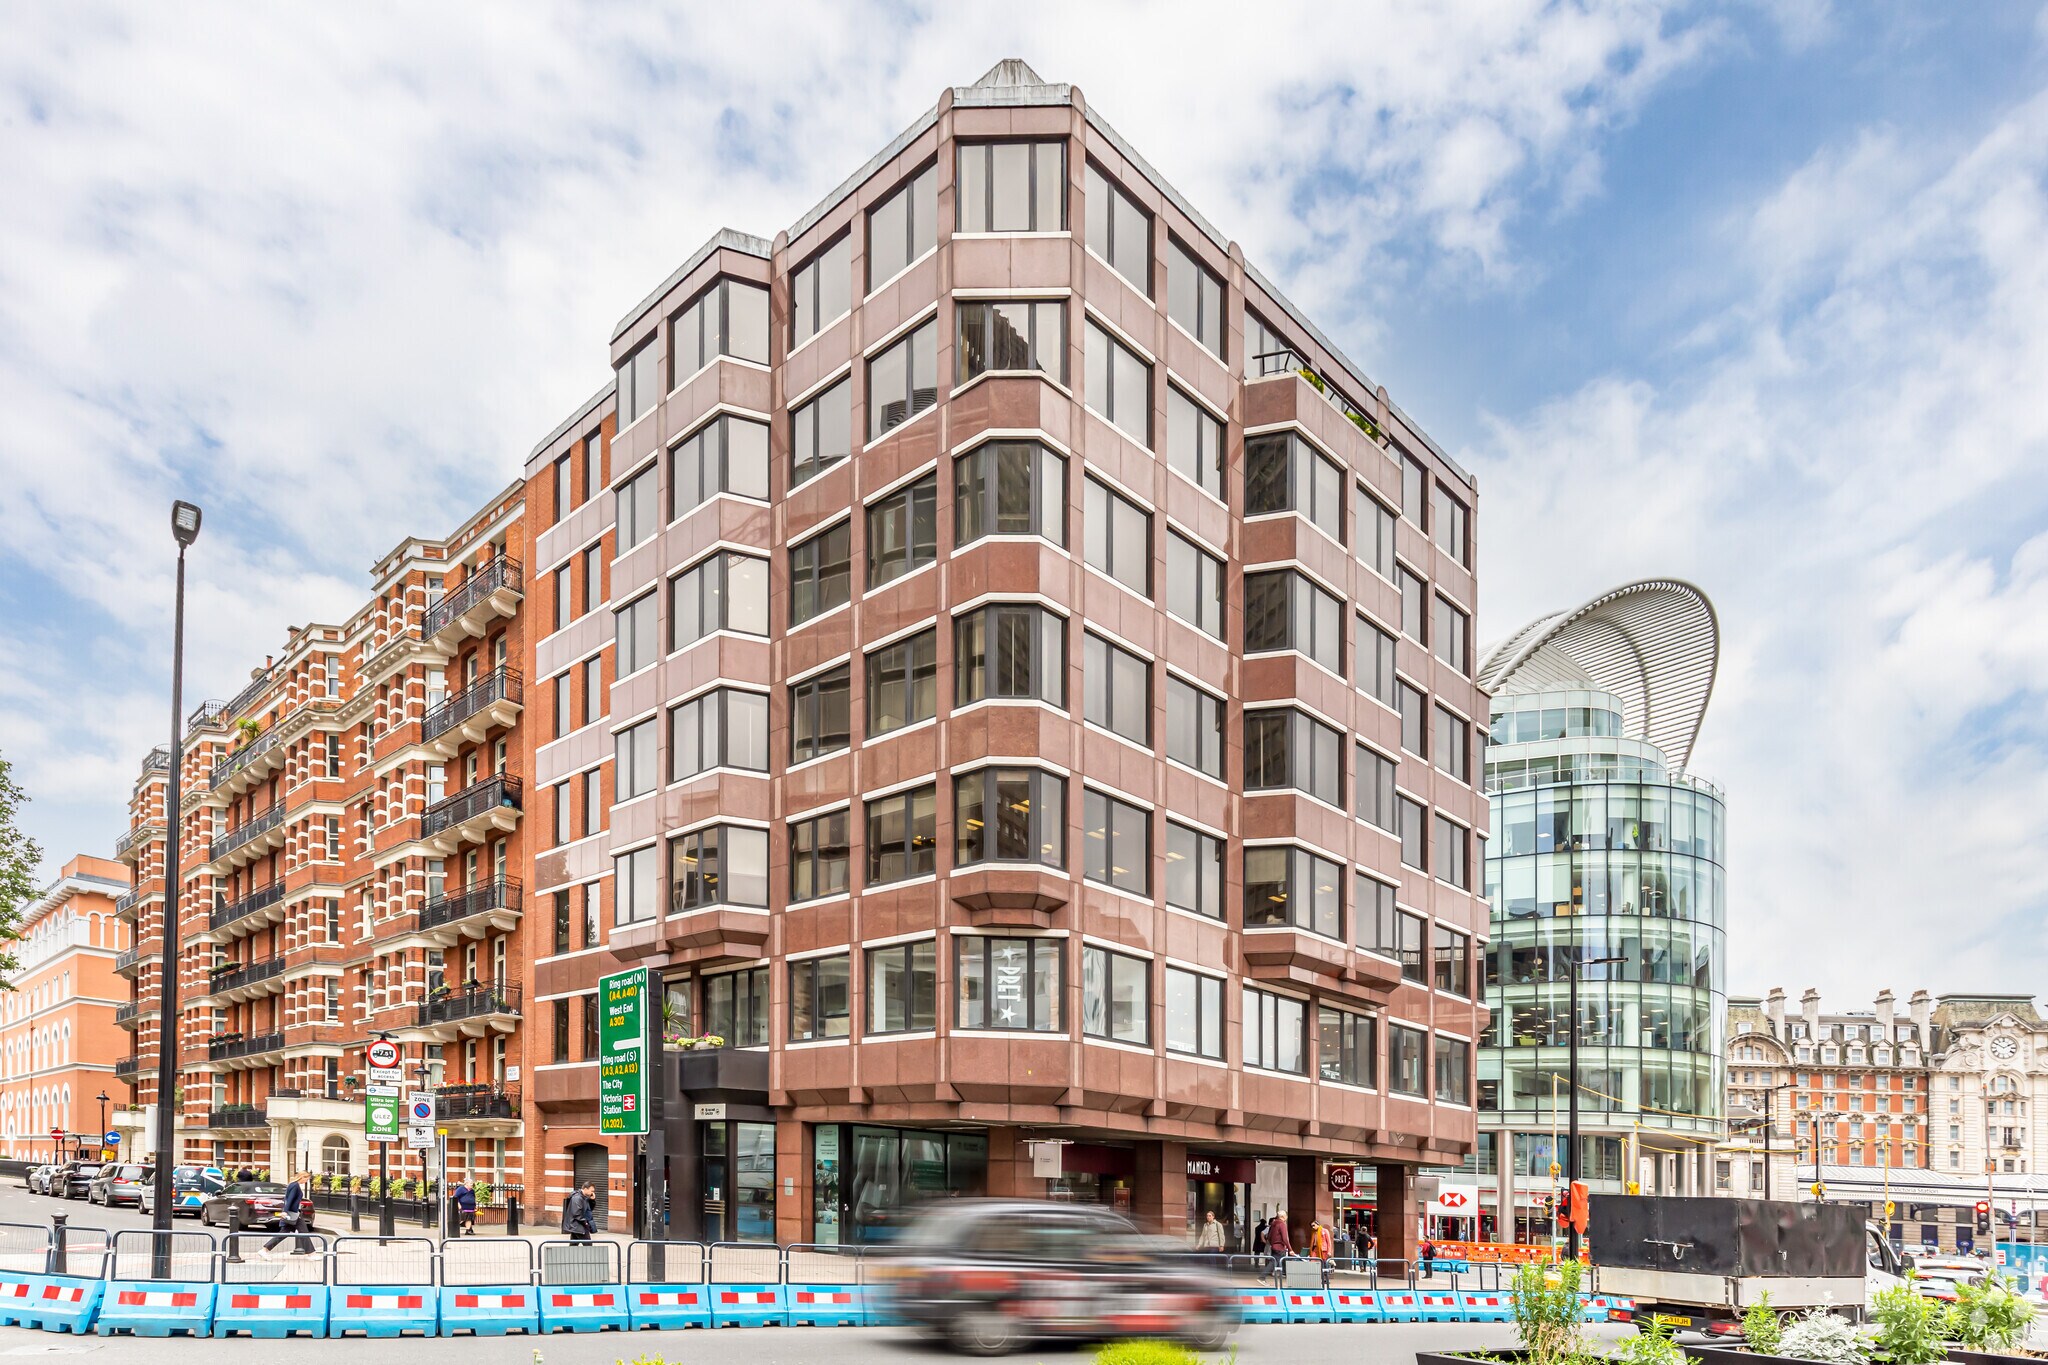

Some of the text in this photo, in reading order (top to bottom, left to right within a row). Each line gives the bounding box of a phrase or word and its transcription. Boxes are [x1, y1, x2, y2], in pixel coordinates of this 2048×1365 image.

[609, 971, 645, 989] Ring road (N)
[997, 966, 1021, 1002] PRET
[622, 985, 638, 998] A40)
[609, 1002, 633, 1015] West End
[609, 1016, 625, 1027] A302
[602, 1050, 637, 1065] Ring road (S)
[624, 1062, 638, 1073] A13)
[602, 1079, 623, 1090] The City
[602, 1093, 622, 1103] Victoria
[603, 1105, 622, 1114] Station
[1187, 1160, 1211, 1175] MANGER
[1334, 1175, 1347, 1183] PRET
